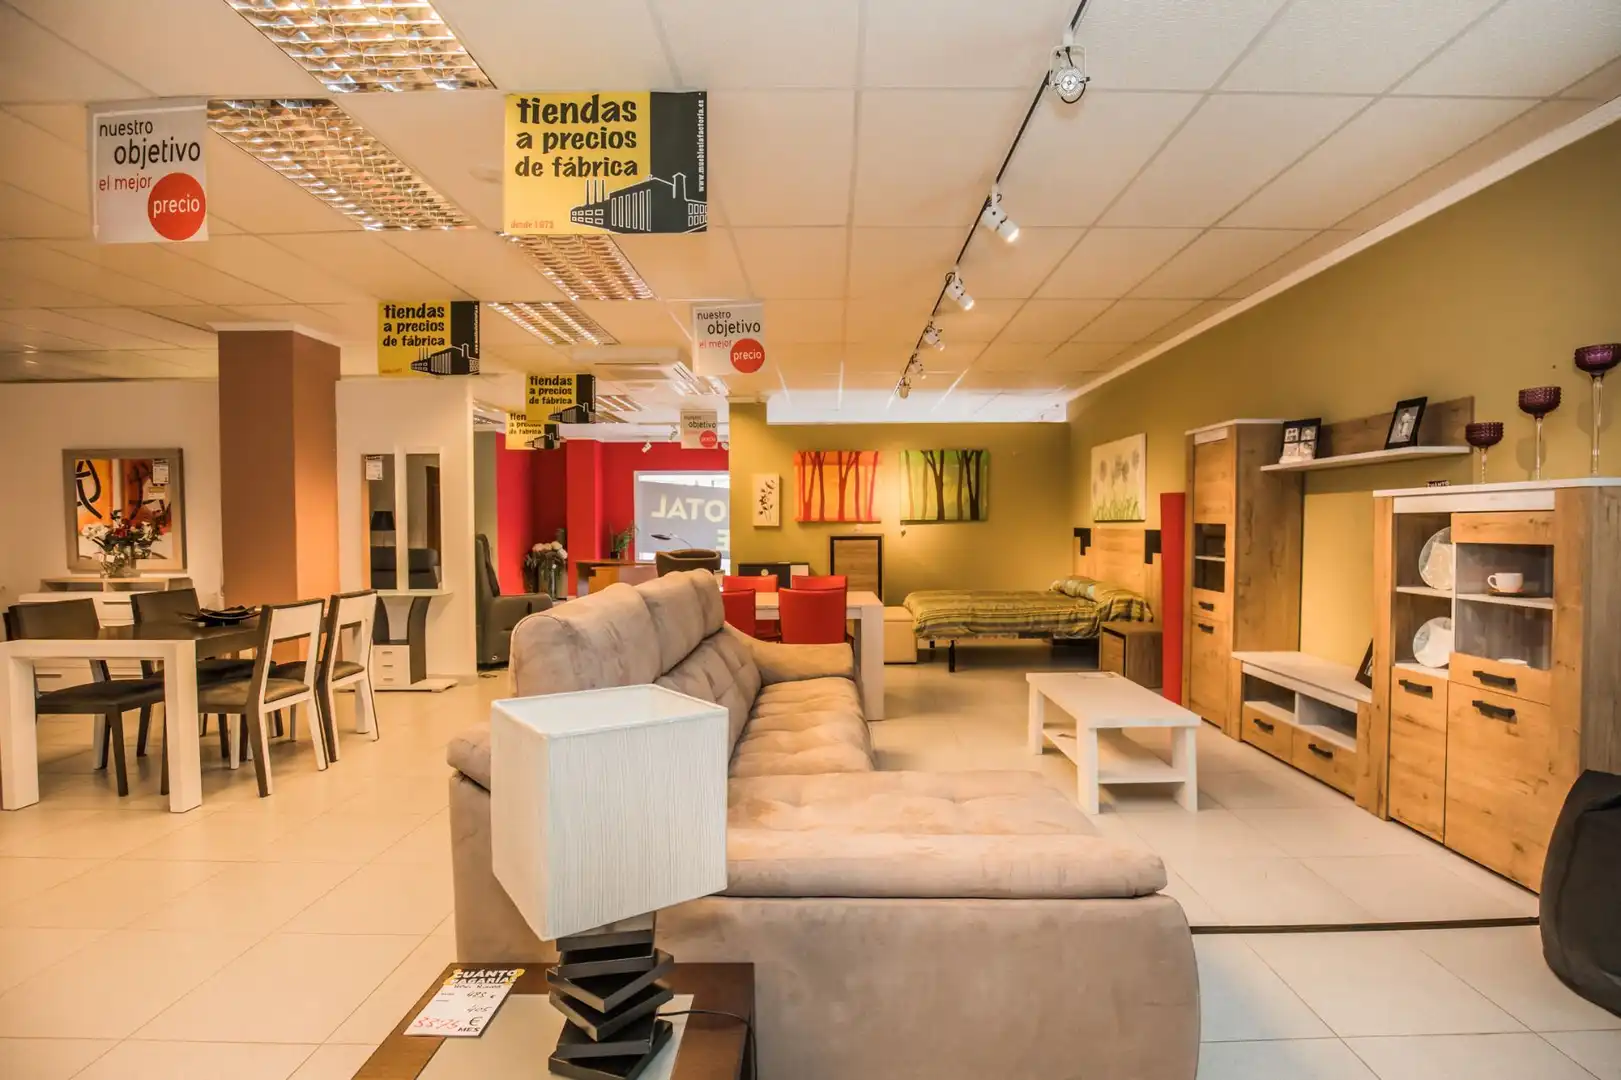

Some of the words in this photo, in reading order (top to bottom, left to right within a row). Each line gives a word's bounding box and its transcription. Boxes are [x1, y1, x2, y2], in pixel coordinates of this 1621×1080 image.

[516, 94, 637, 124] tiendas
[99, 120, 154, 137] nuestro
[516, 131, 533, 149] a
[542, 126, 637, 154] precios
[113, 136, 201, 170] objetivo
[514, 156, 544, 177] de
[552, 156, 638, 177] fábrica
[98, 175, 110, 191] el
[113, 173, 153, 193] mejor
[153, 194, 200, 219] precio
[383, 302, 445, 319] tiendas
[696, 310, 732, 320] nuestro
[383, 322, 392, 332] a
[396, 320, 445, 334] precios
[707, 319, 761, 338] objetivo
[382, 335, 398, 346] de
[401, 335, 445, 347] fábrica
[699, 339, 707, 349] el
[708, 338, 732, 350] mejor
[733, 349, 762, 363] precio
[529, 375, 572, 386] tiendas
[538, 387, 572, 396] precios
[528, 396, 540, 404] de
[509, 413, 527, 421] tien
